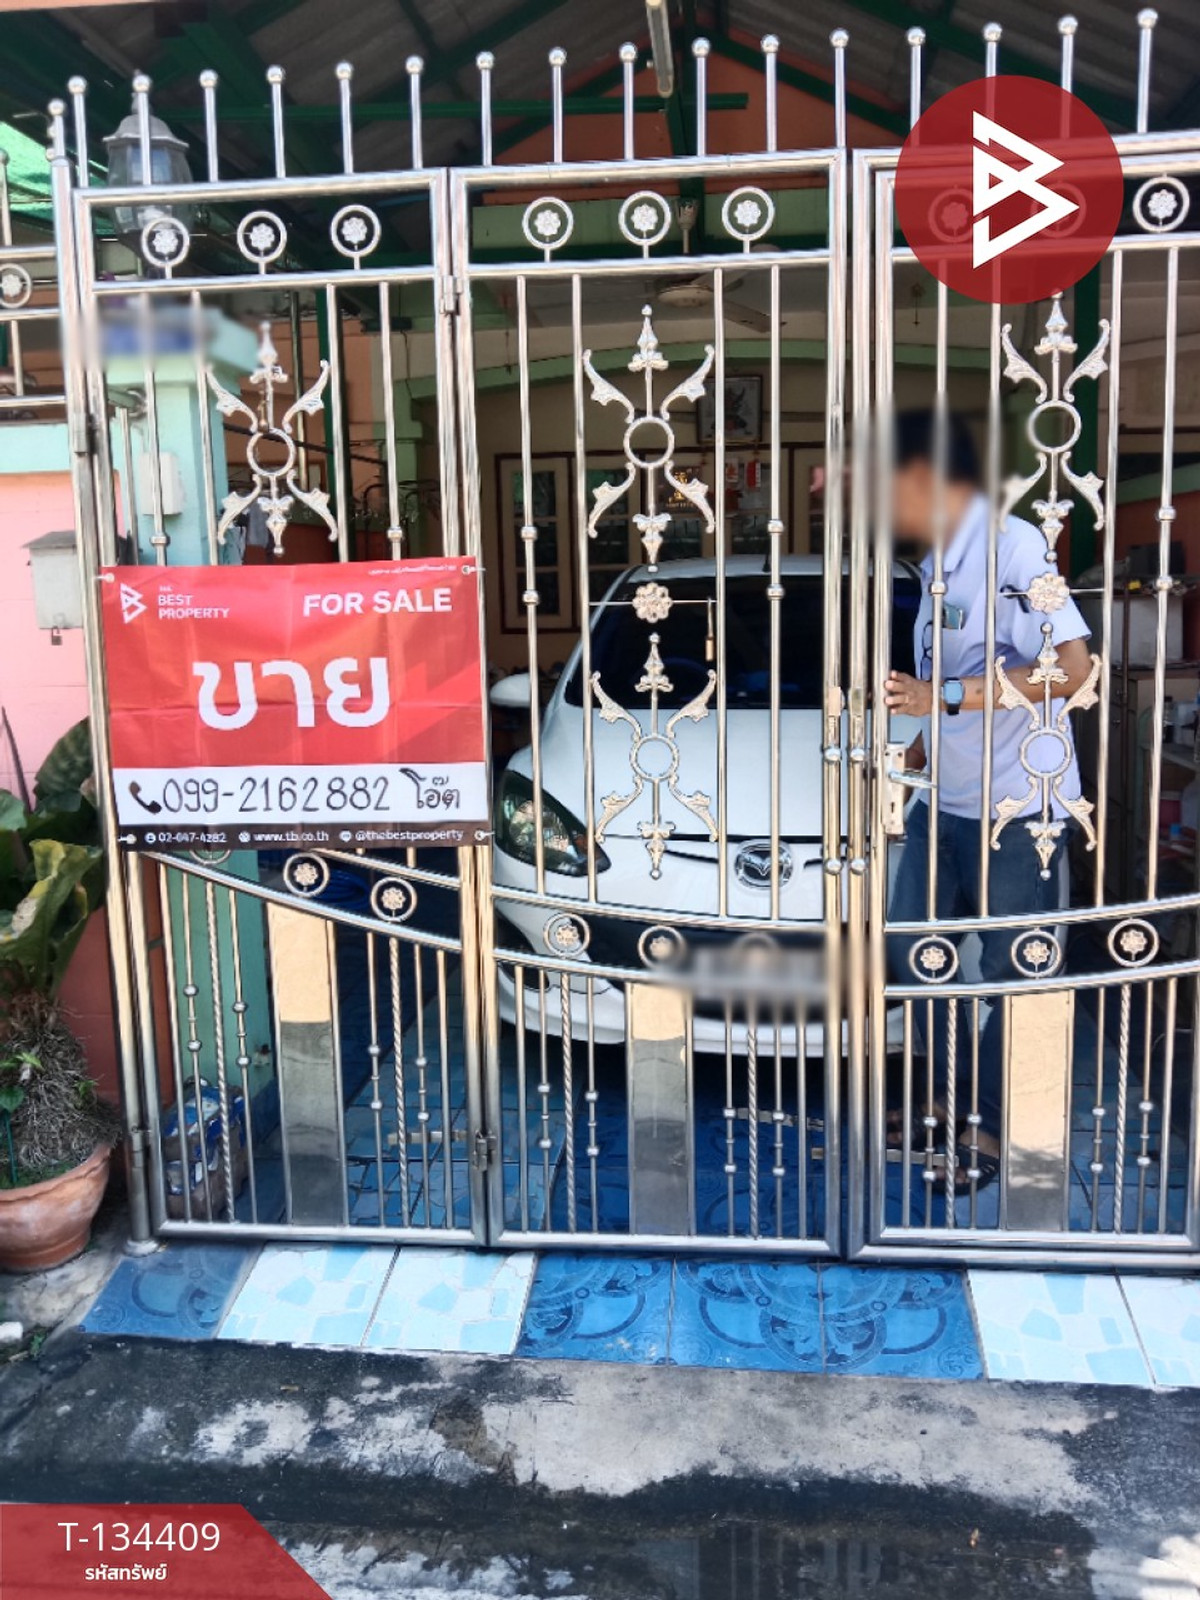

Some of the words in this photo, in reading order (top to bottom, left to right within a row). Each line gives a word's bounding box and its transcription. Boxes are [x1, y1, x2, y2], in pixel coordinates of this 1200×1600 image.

[158, 594, 193, 606] BEST
[303, 592, 364, 617] FOR
[372, 587, 453, 613] SALE
[158, 608, 230, 620] PROPERTY
[192, 656, 391, 731] ขาย
[162, 776, 391, 814] 099-2162882
[355, 829, 464, 842] @thebestproperty
